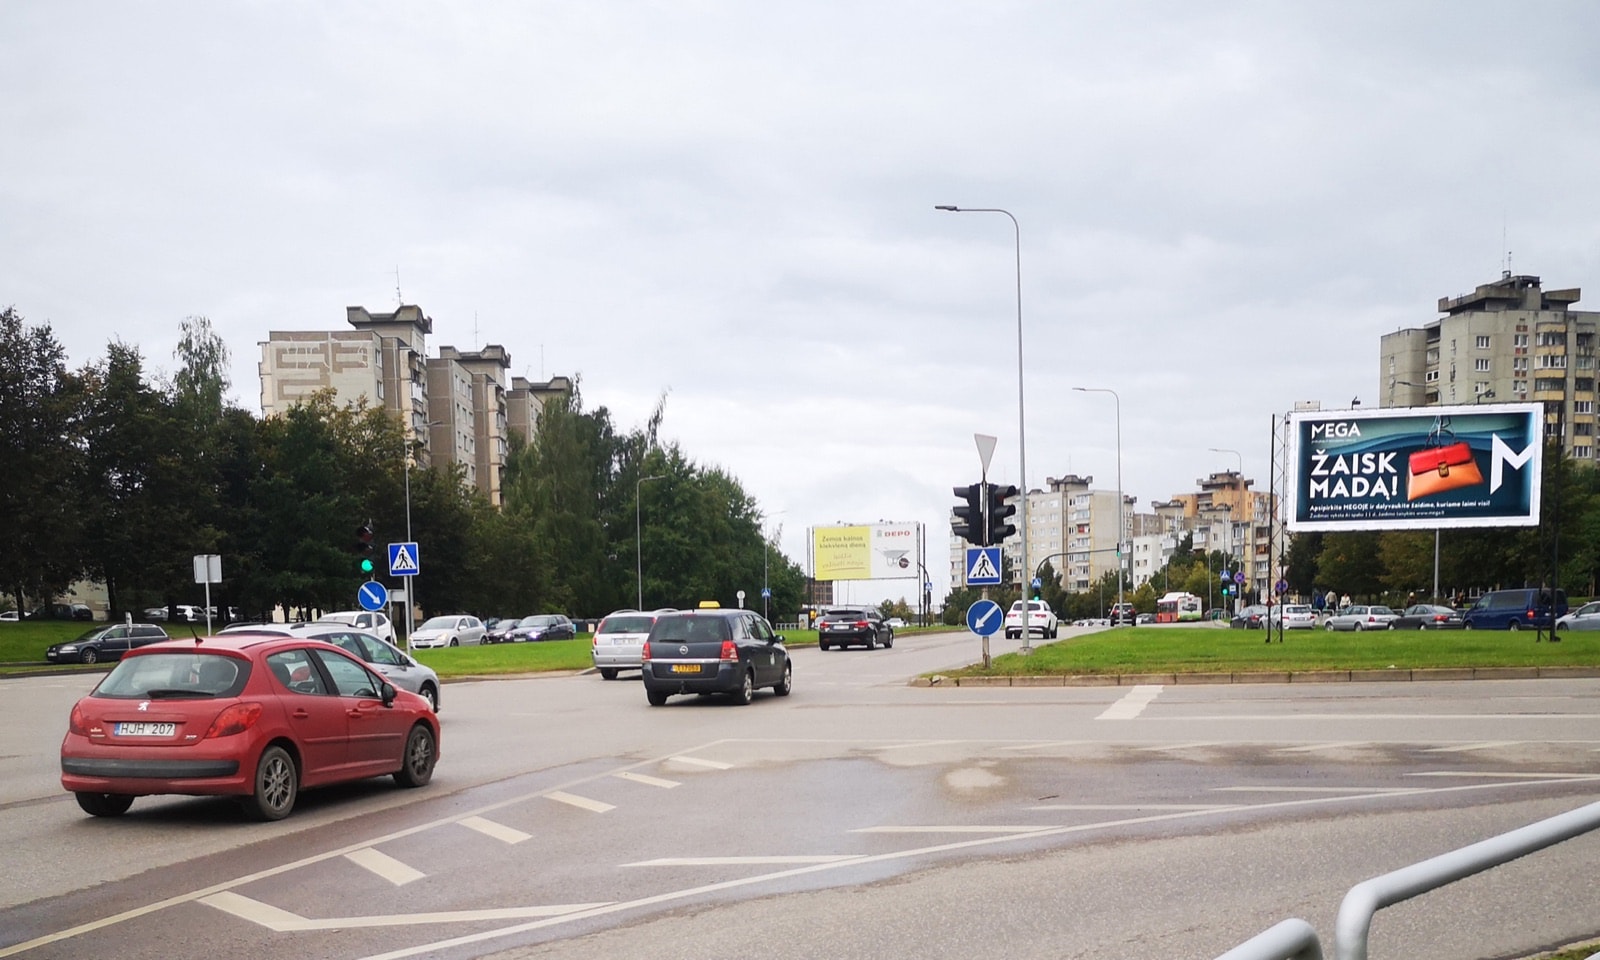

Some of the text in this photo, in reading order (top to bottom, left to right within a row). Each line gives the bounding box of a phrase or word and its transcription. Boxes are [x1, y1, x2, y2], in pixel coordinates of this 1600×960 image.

[1312, 422, 1361, 439] MEGA
[1311, 449, 1397, 476] ŽAISK
[1310, 476, 1398, 500] MADĄ!
[1343, 503, 1368, 511] MEGOJE
[120, 723, 174, 735] HJH 207
